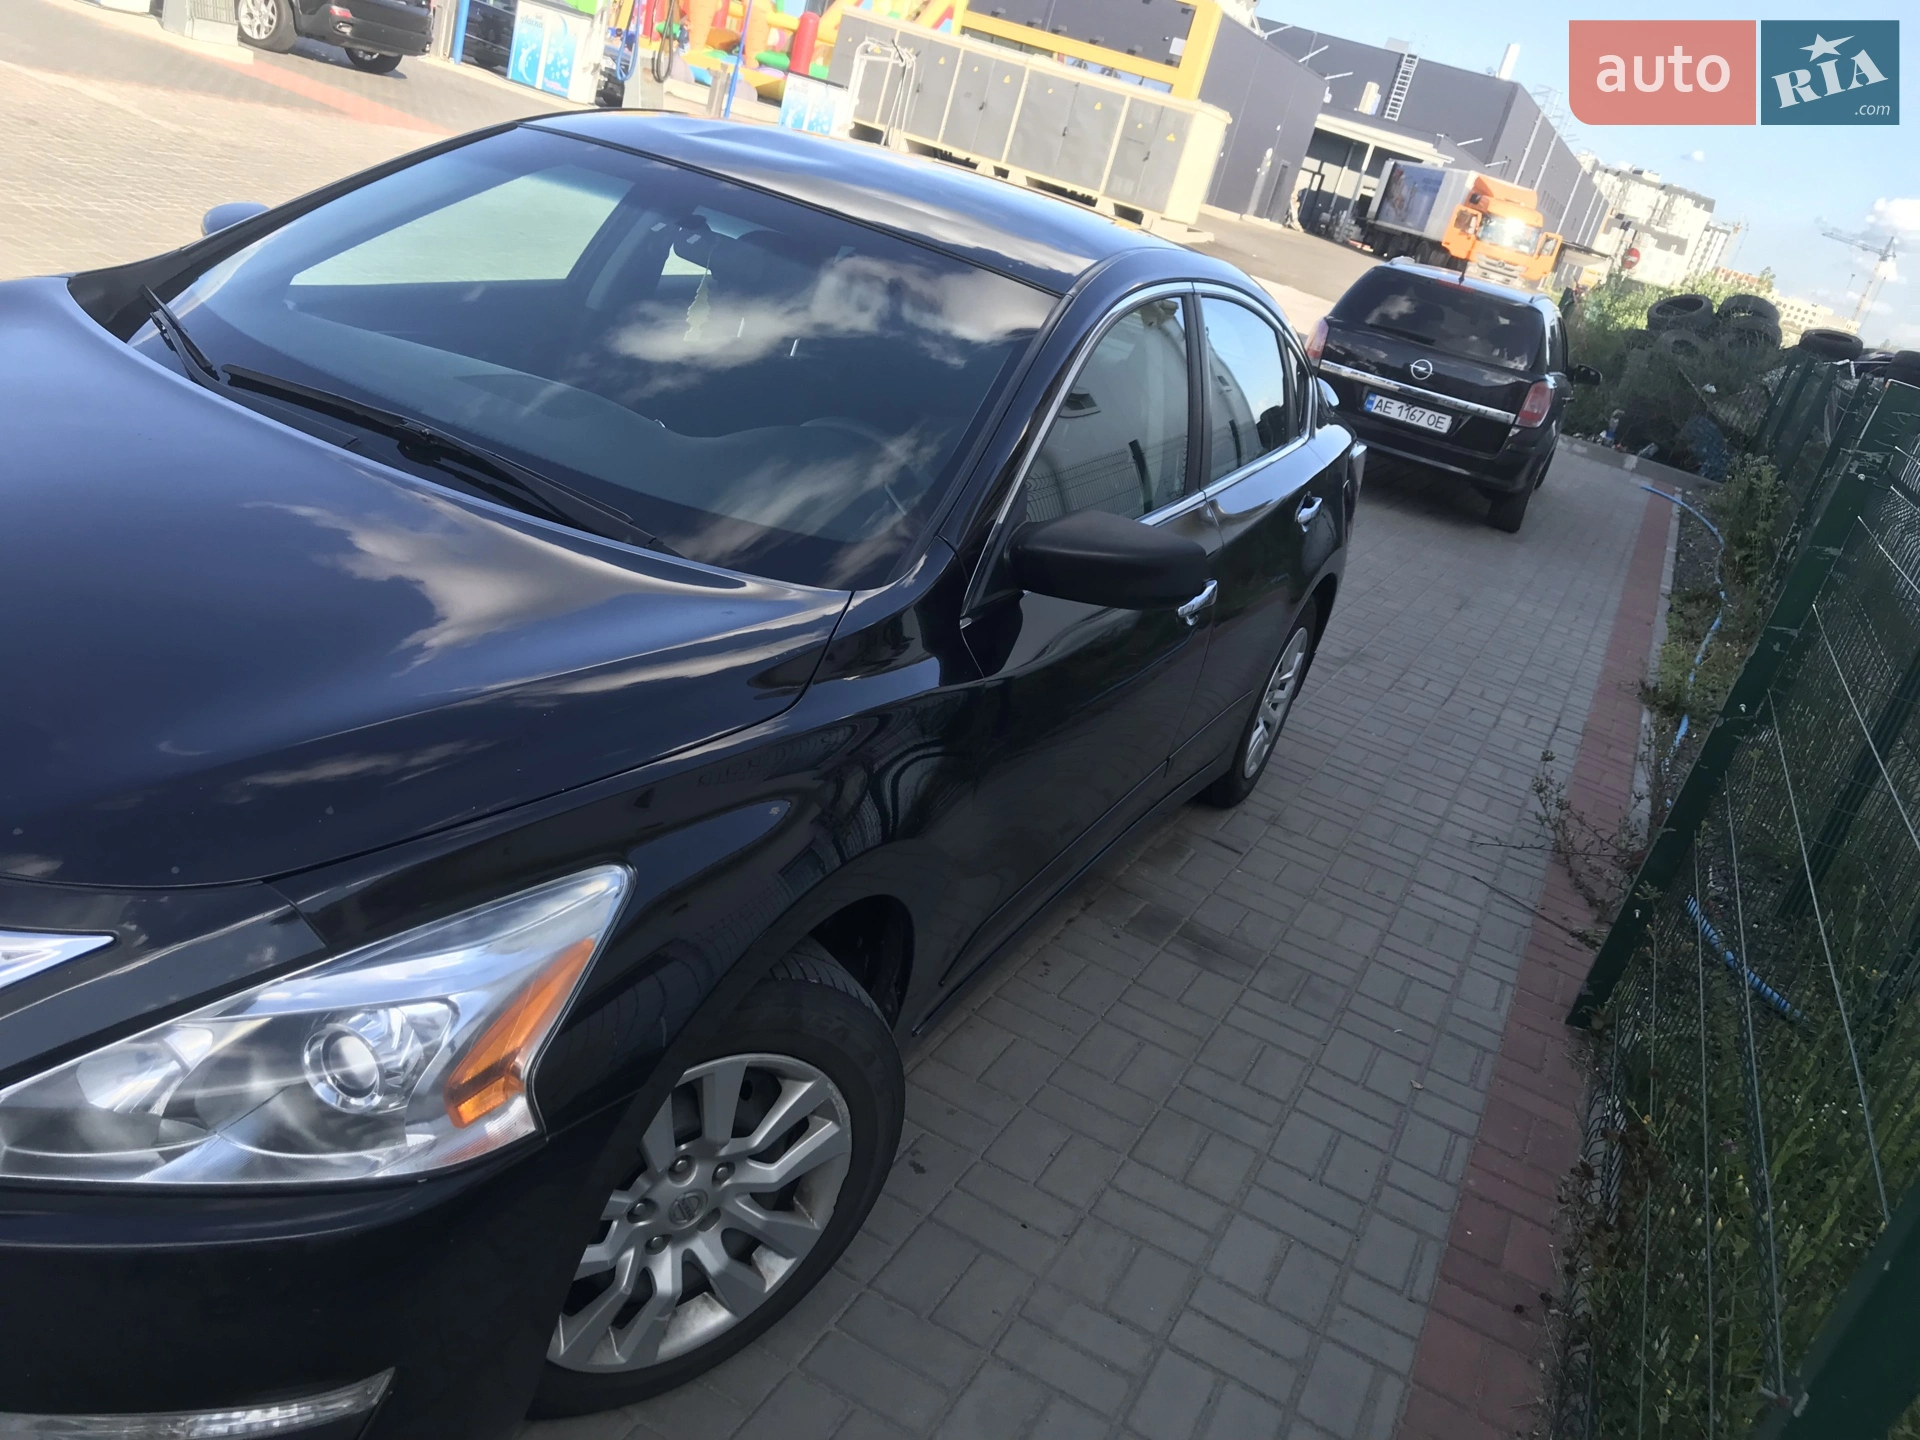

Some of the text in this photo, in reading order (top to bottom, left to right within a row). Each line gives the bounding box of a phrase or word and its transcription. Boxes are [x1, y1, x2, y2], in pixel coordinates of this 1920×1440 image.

[1374, 399, 1446, 429] AE 1167 OE
